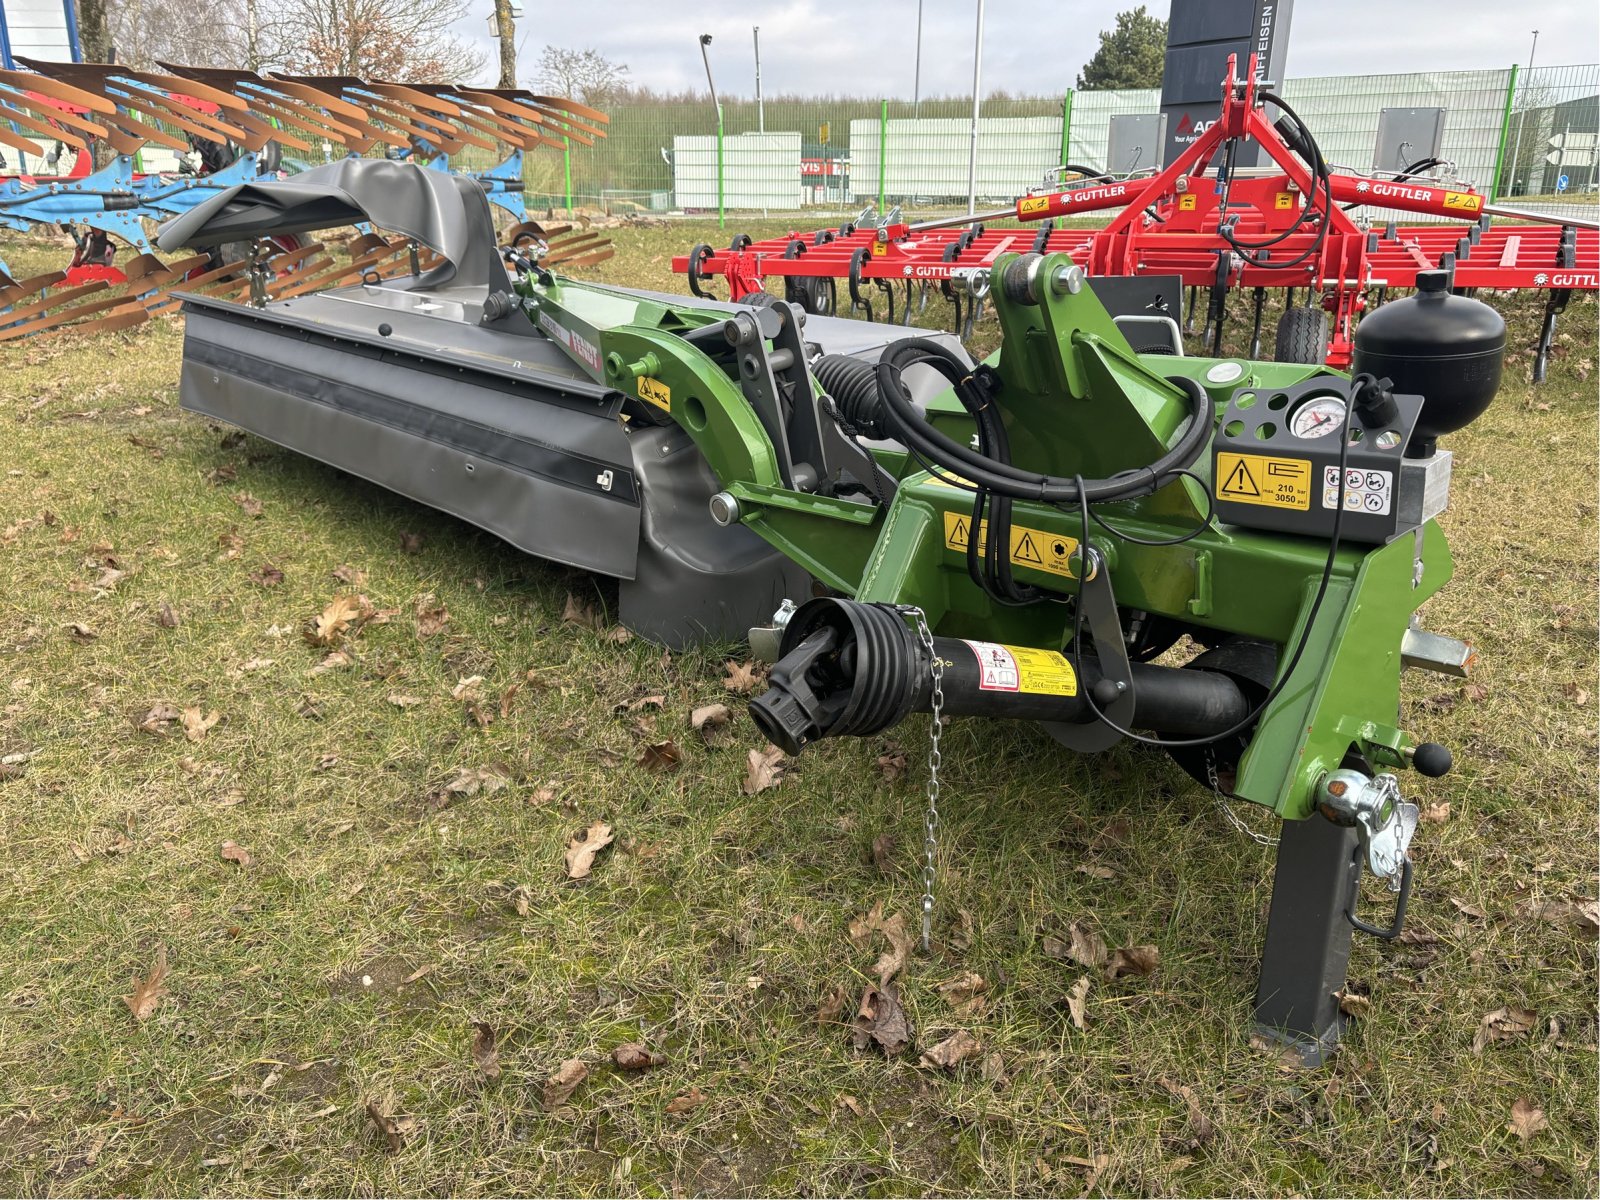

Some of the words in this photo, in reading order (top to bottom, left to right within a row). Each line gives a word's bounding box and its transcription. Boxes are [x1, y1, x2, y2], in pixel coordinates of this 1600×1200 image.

[1254, 5, 1273, 86] AIFFEISEN
[916, 266, 956, 277] GÜTTLE
[1552, 274, 1599, 286] GÜTTL
[570, 329, 598, 369] FENDT
[1277, 484, 1294, 493] 210
[1275, 493, 1296, 503] 3050
